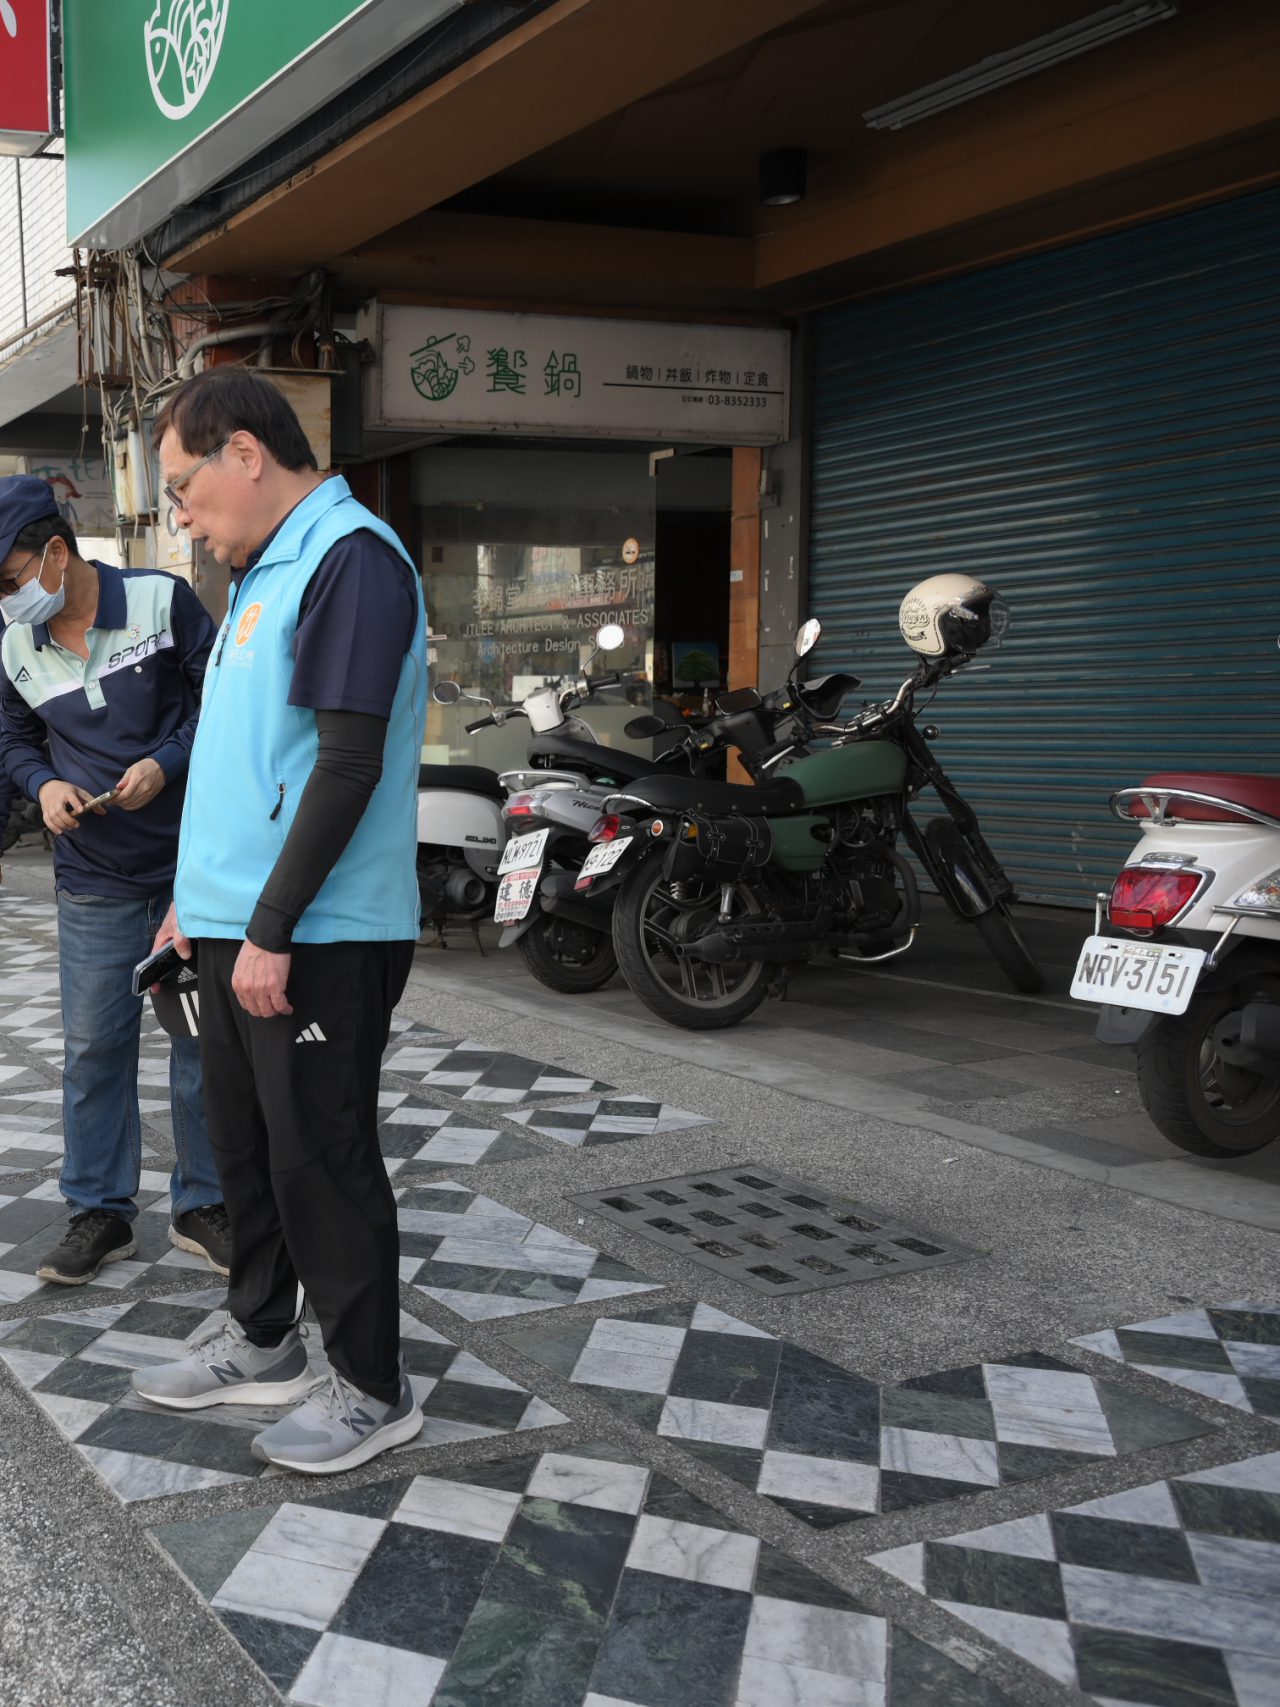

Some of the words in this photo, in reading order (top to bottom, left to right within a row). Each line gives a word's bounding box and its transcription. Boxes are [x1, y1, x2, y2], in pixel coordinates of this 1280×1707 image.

[486, 346, 581, 399] 饗鍋
[626, 365, 653, 382] 鍋物
[665, 367, 692, 384] 丼飯
[704, 370, 732, 386] 炸物
[743, 372, 769, 388] 定食
[708, 395, 767, 408] 03-8352333
[499, 614, 554, 634] ARCHITECT
[577, 608, 650, 629] ASSOCIATES
[477, 641, 539, 657] Architecture
[545, 637, 581, 652] Design
